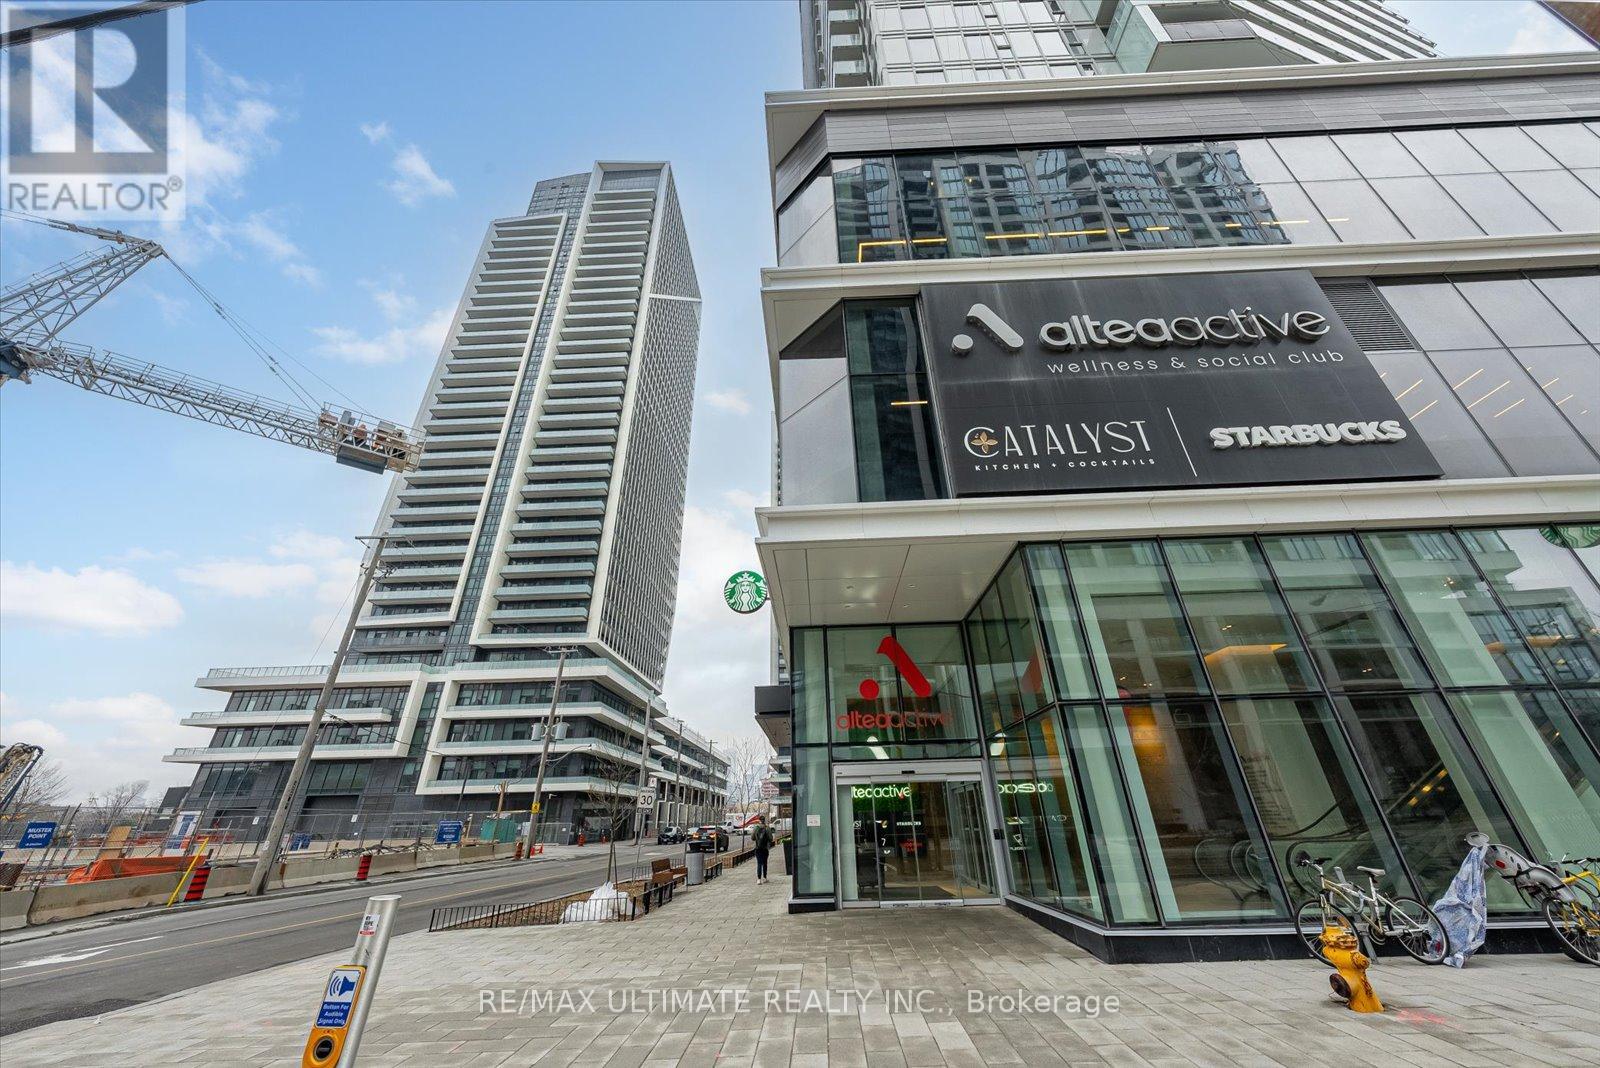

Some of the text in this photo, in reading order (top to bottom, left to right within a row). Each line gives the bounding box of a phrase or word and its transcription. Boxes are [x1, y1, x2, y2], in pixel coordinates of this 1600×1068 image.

[1039, 307, 1331, 351] alteaactive
[1047, 350, 1345, 374] wellness & social club
[964, 420, 1152, 458] CATALYST
[1209, 420, 1408, 449] STARBUCKS
[974, 462, 1041, 472] KITCHEN
[1068, 458, 1156, 469] COCKTAILS
[640, 795, 653, 805] 30
